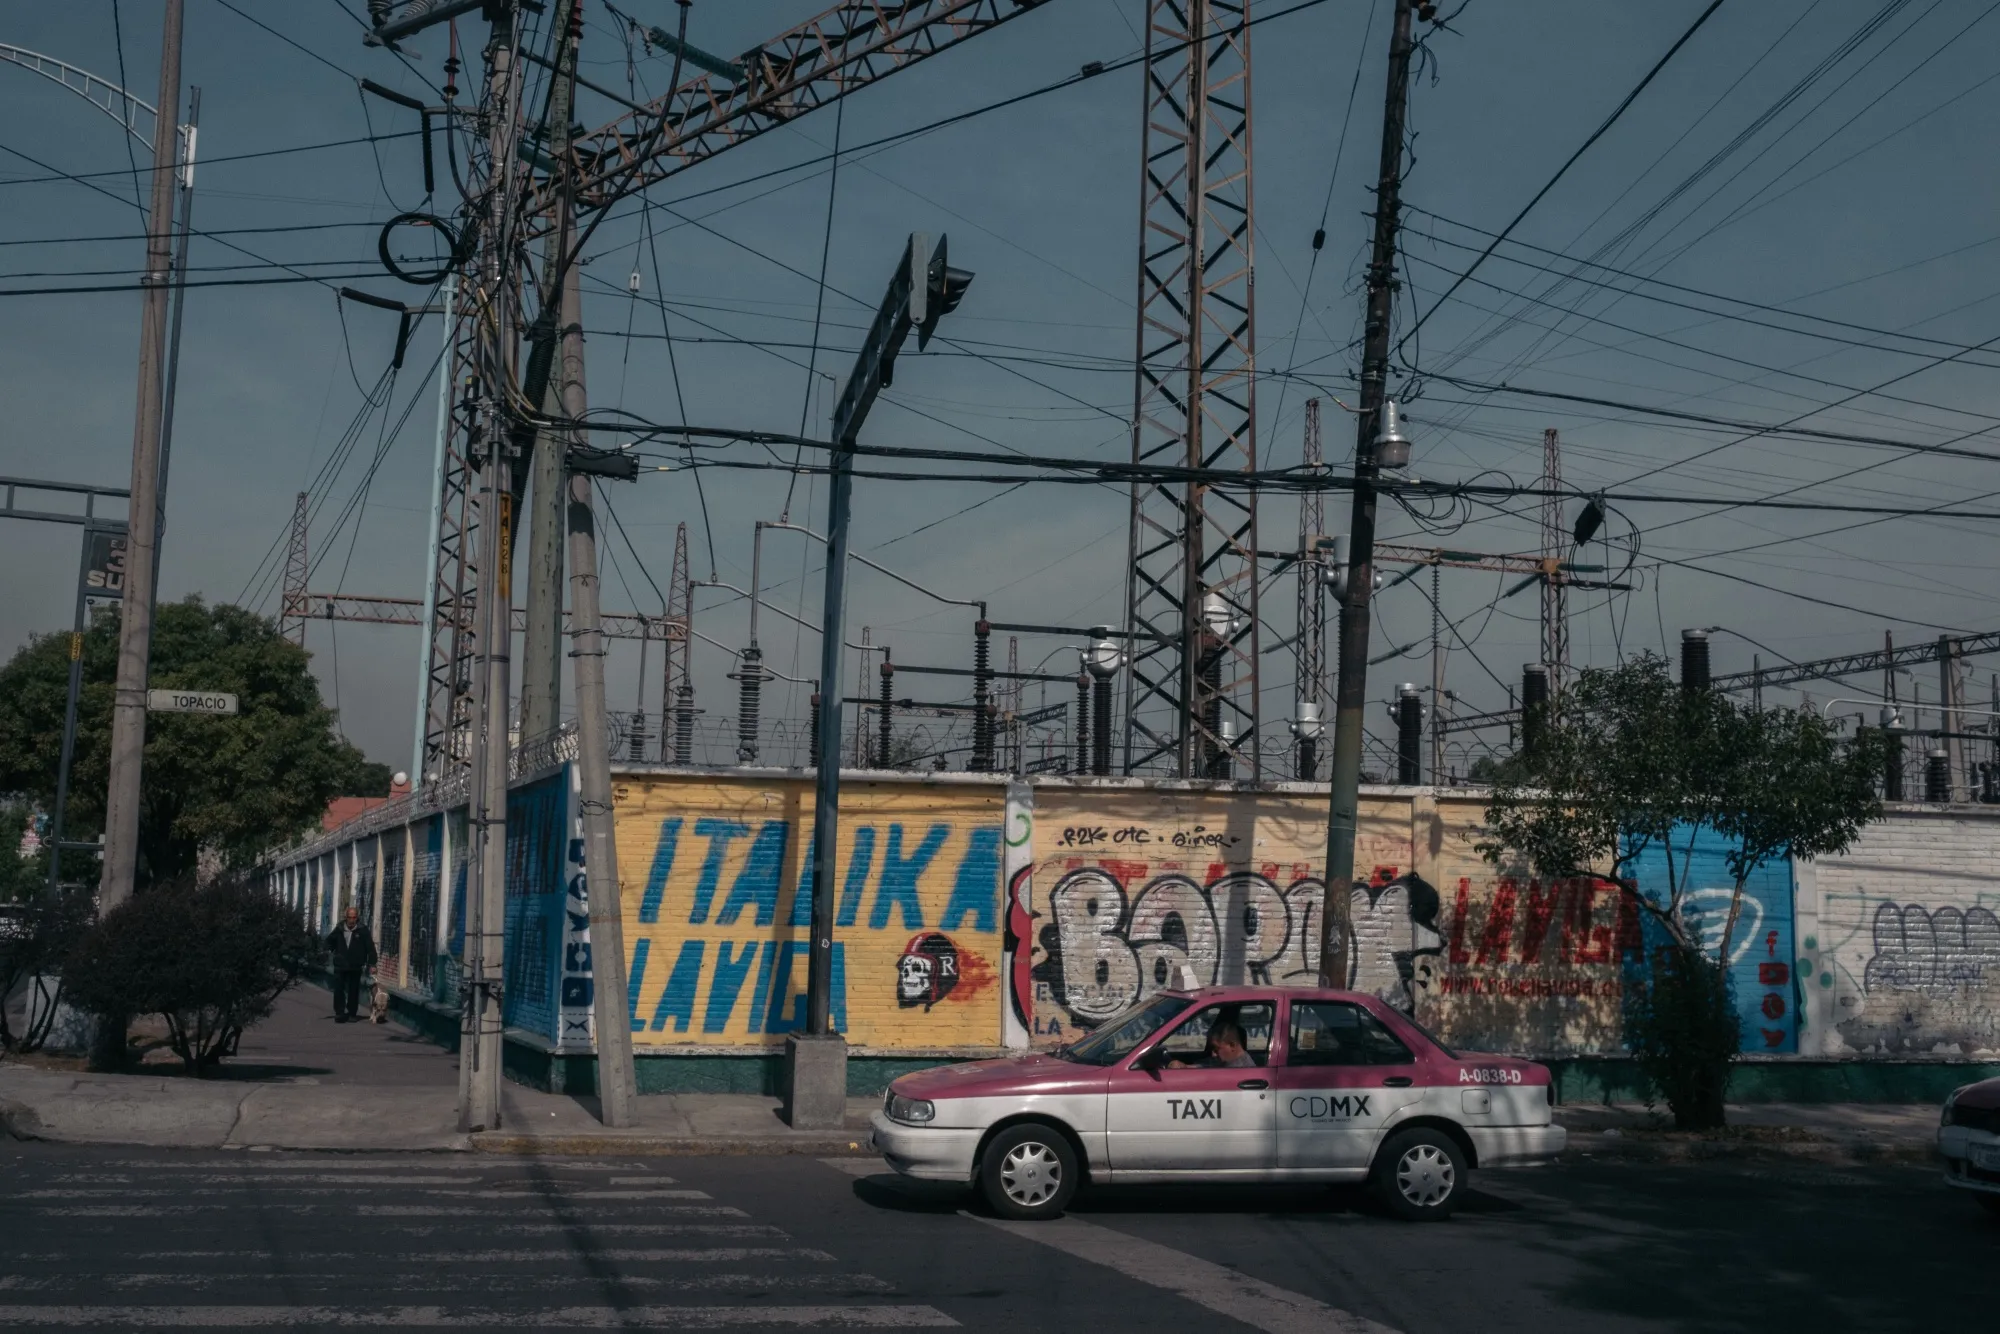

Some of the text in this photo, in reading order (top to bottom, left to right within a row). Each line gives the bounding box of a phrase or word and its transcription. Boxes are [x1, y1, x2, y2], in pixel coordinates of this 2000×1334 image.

[110, 539, 127, 549] EJ
[106, 549, 127, 573] 3
[86, 569, 125, 590] SU
[172, 695, 226, 709] TOPACIO
[939, 956, 957, 976] R
[1034, 1016, 1061, 1035] LA
[1460, 1068, 1522, 1083] A-0838-D
[1167, 1099, 1222, 1119] TAXI
[1290, 1095, 1372, 1118] CDMX
